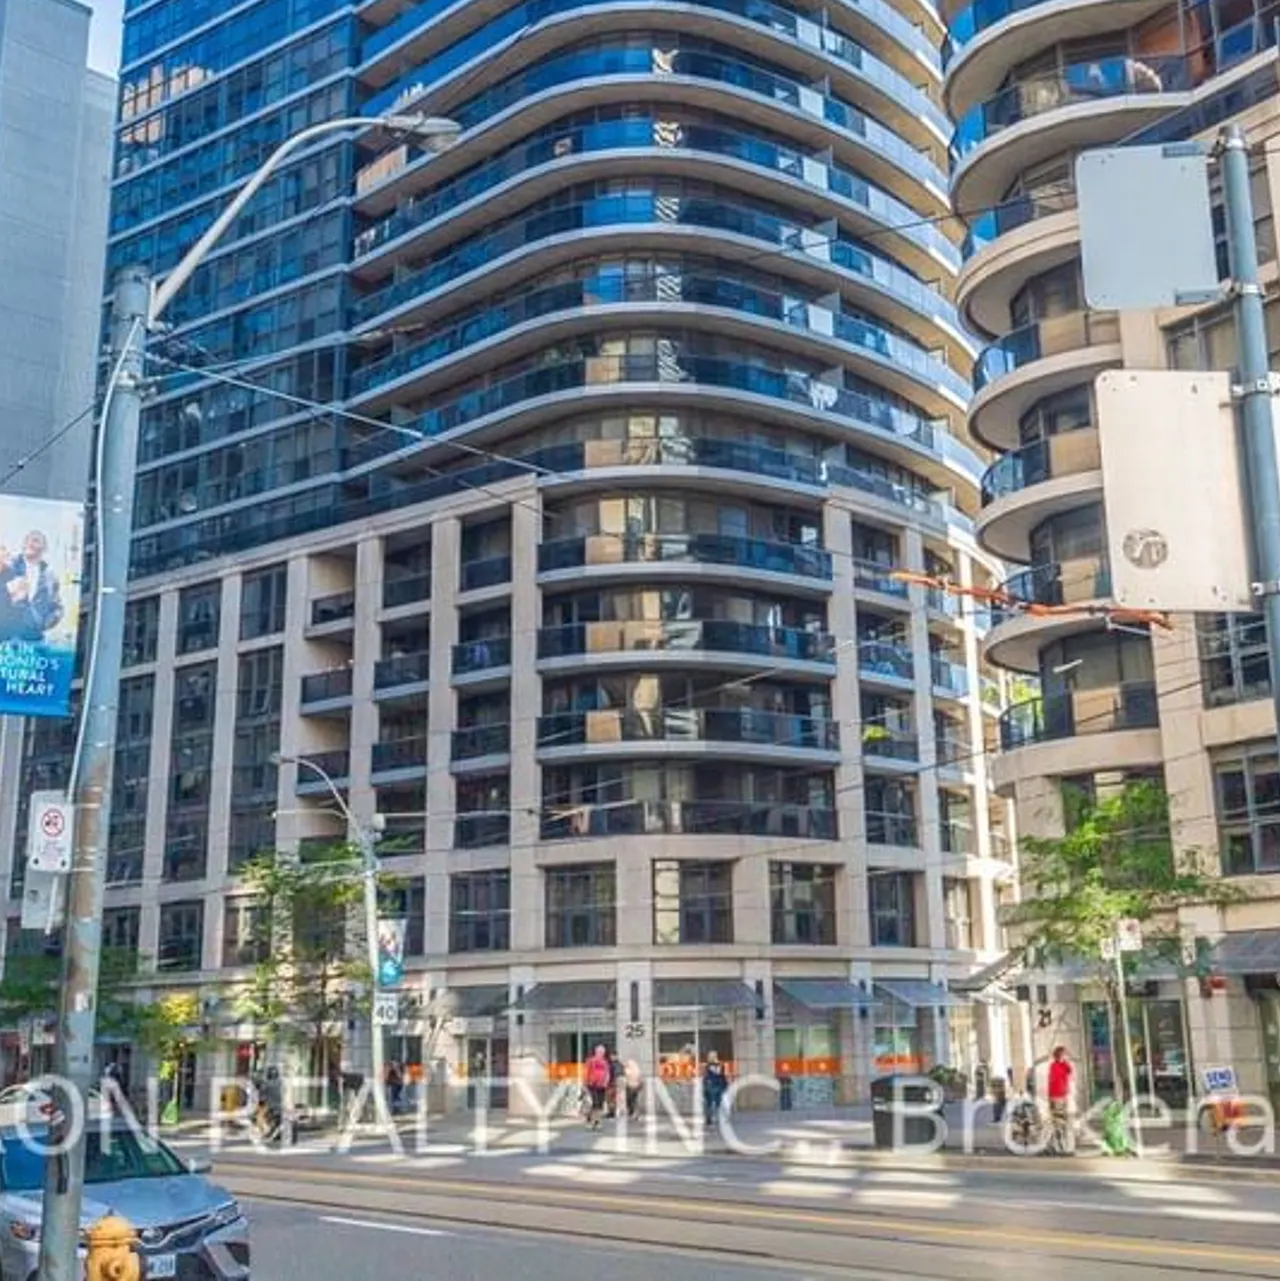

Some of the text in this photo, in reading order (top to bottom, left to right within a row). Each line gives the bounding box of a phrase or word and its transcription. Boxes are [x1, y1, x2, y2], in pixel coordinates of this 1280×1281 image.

[18, 641, 35, 654] IN
[6, 681, 55, 696] HEART
[376, 1006, 395, 1019] 40
[625, 1024, 645, 1038] 25
